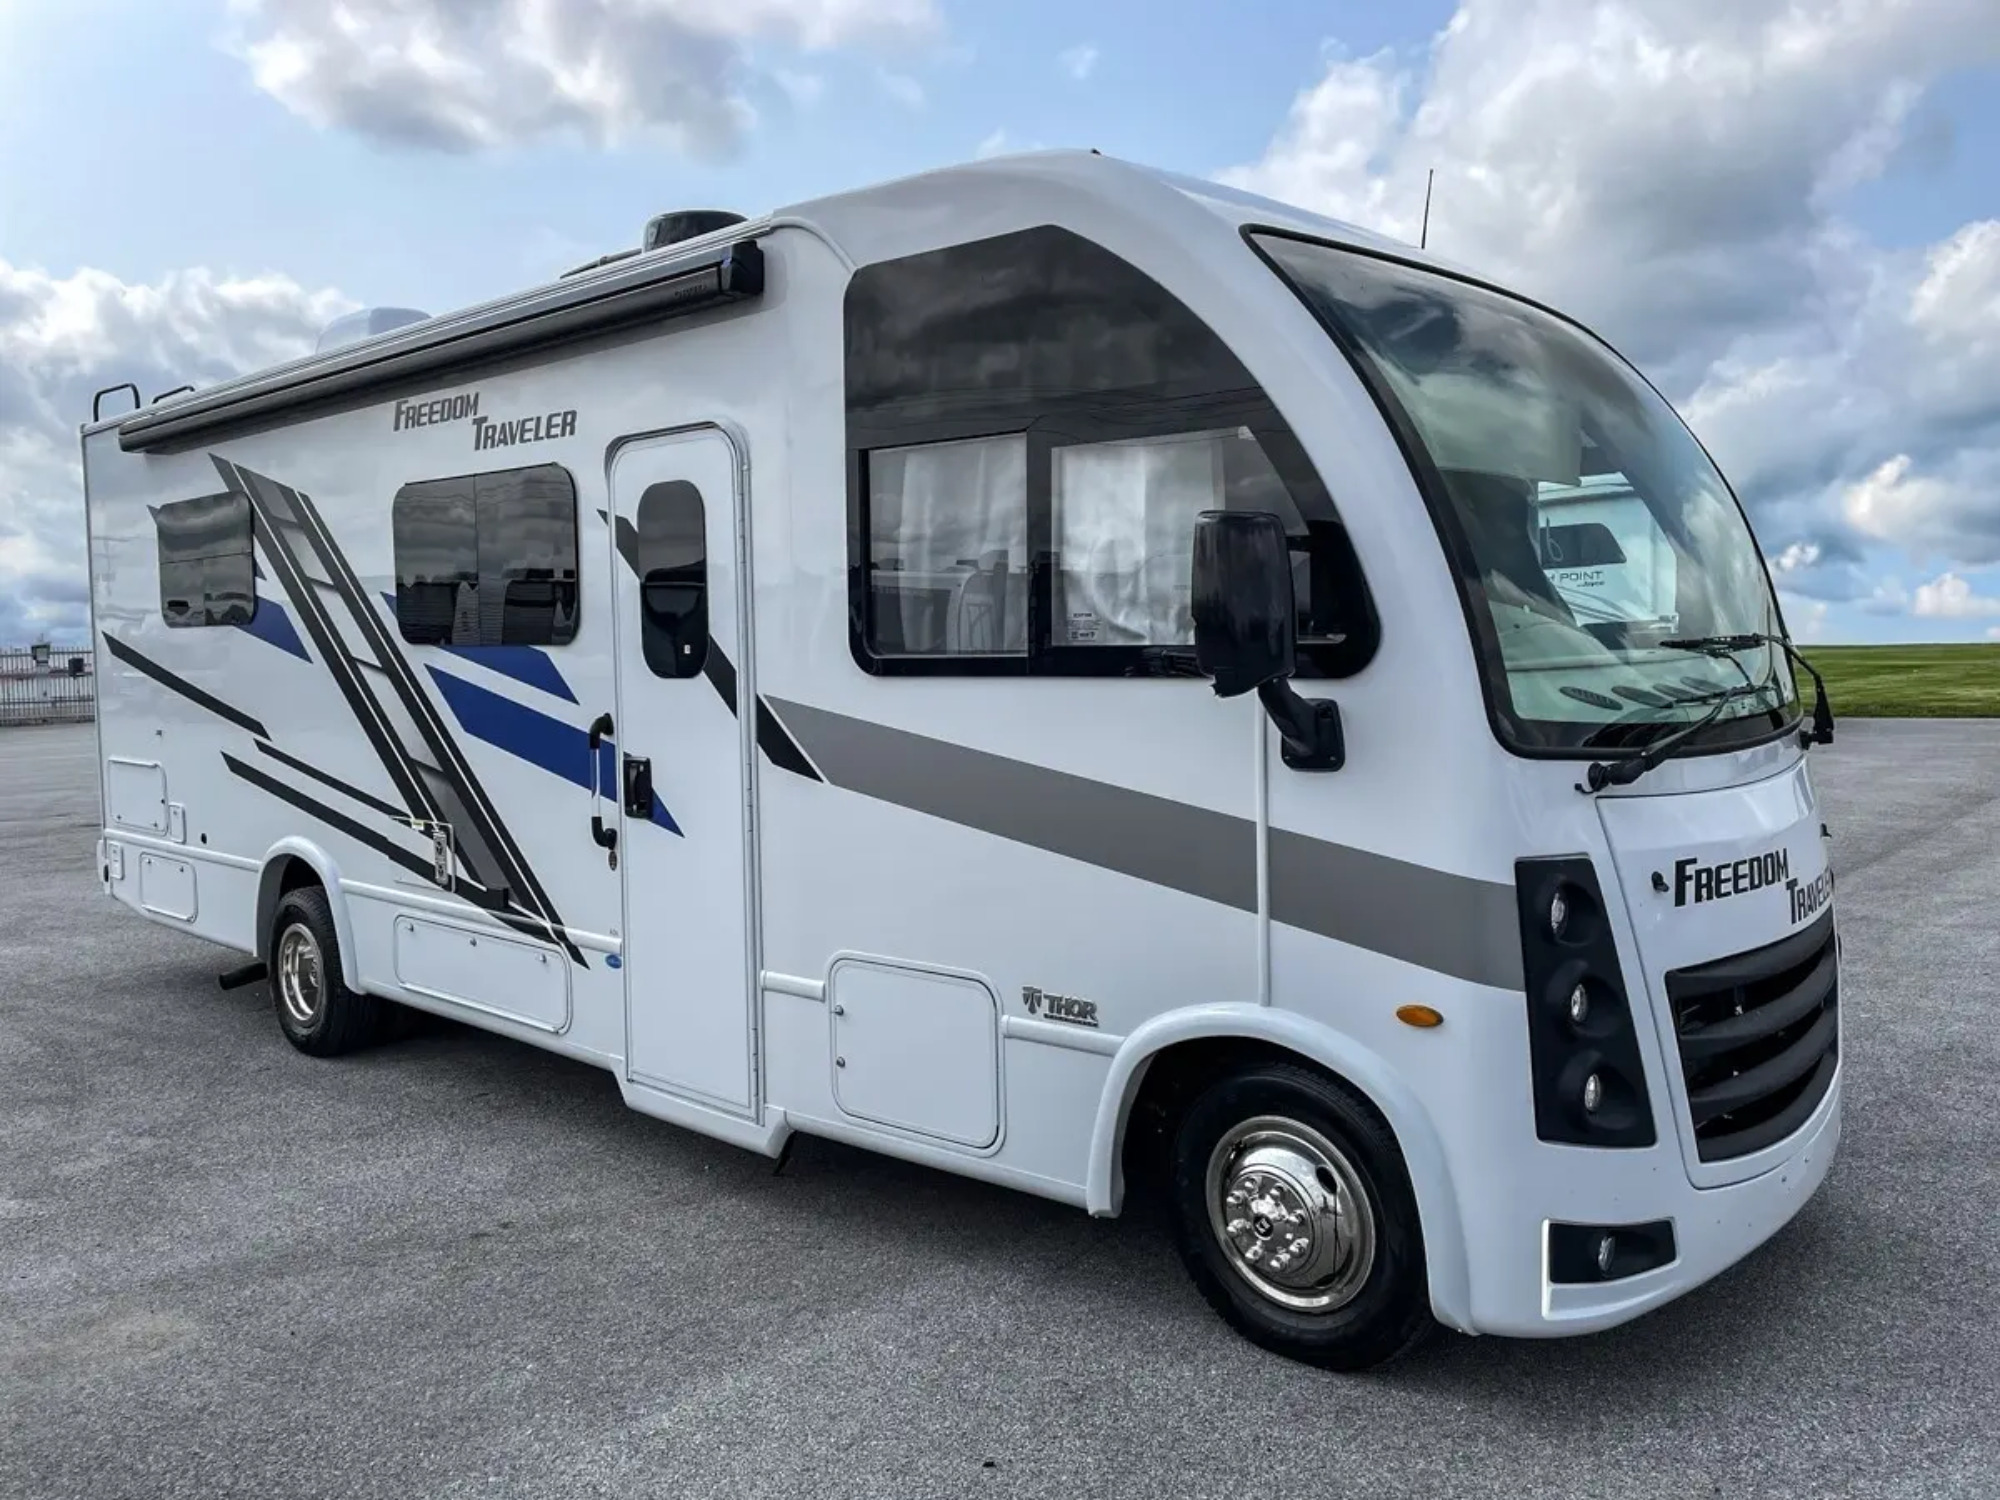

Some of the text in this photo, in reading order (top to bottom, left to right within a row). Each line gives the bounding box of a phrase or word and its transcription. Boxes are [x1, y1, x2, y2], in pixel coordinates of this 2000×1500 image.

[393, 392, 479, 431] FREEDOM
[472, 410, 577, 450] TRAVELER
[1560, 571, 1603, 582] POINT
[1674, 848, 1789, 907] FREEDOM
[1786, 865, 1830, 925] TRAVELE
[1043, 993, 1098, 1021] THOR
